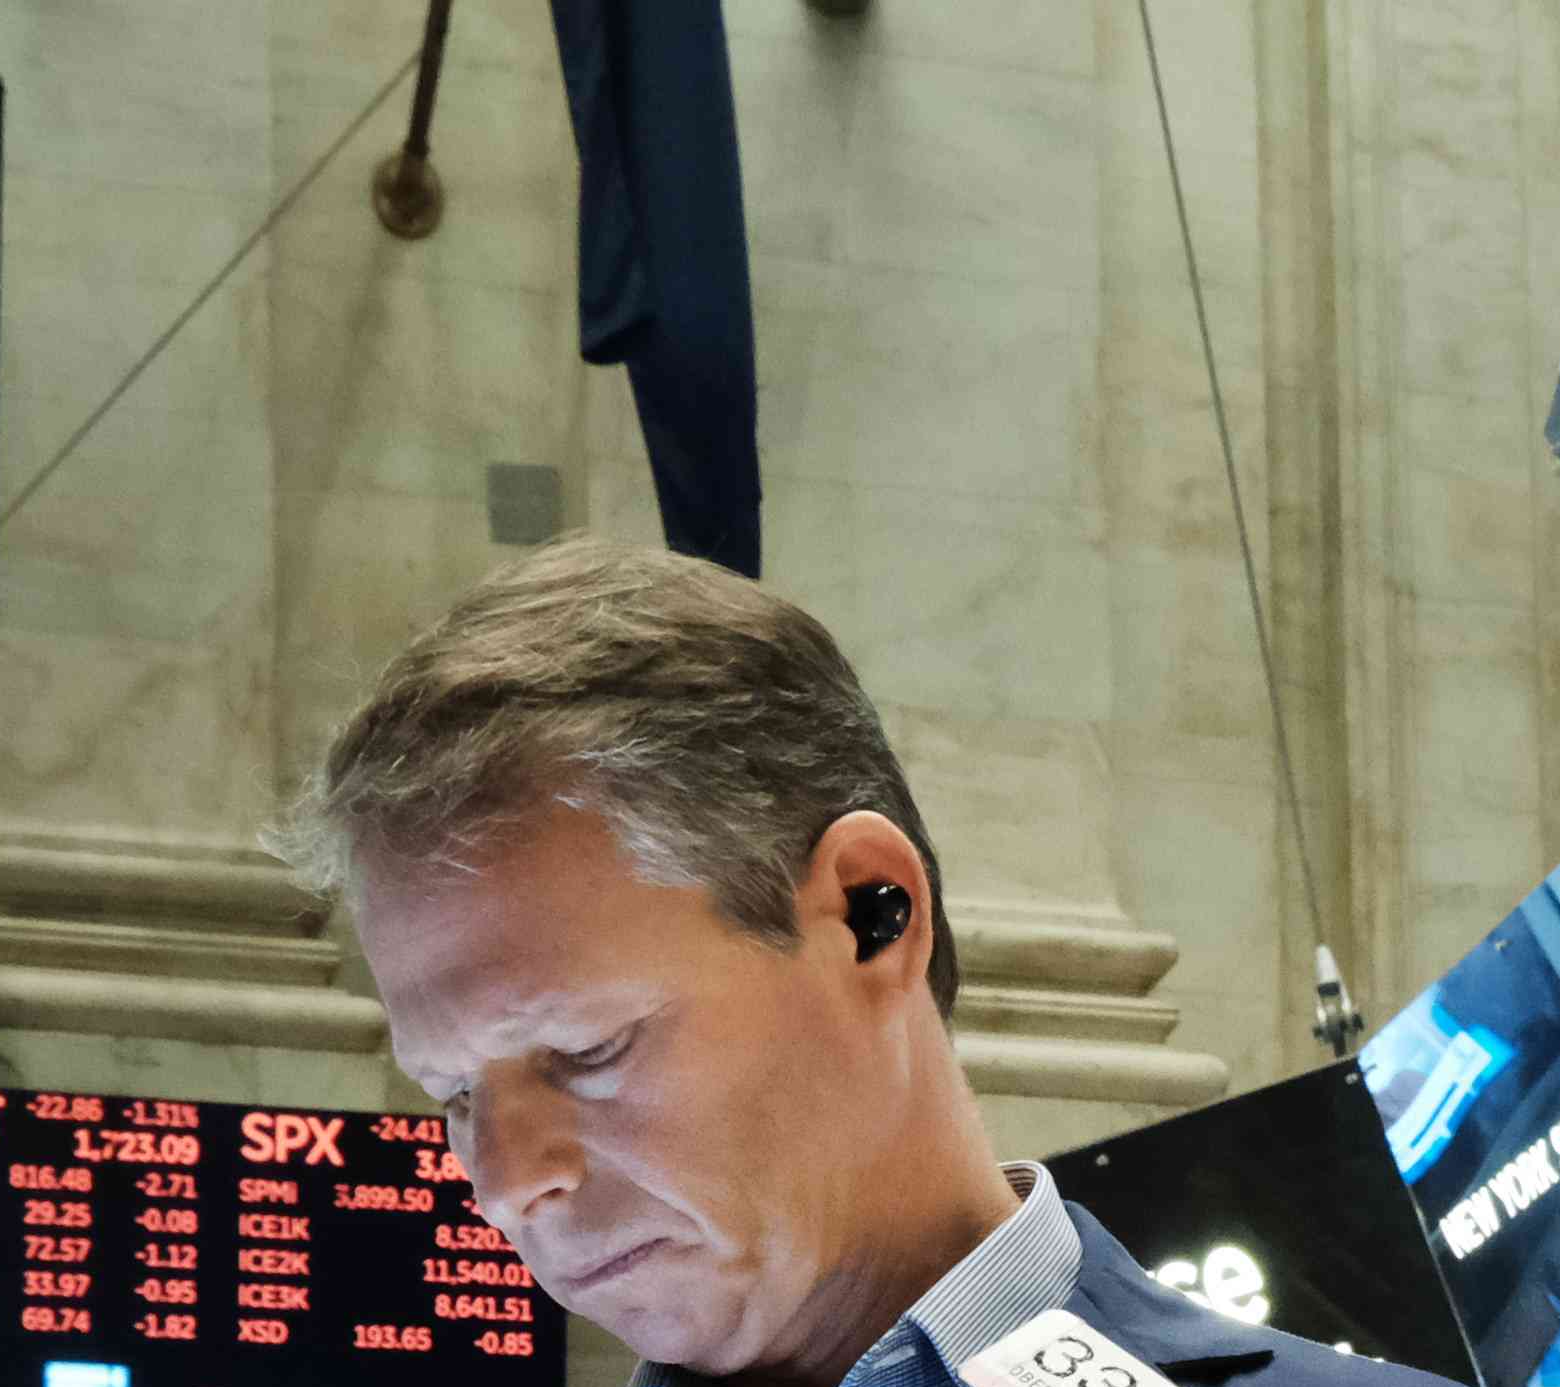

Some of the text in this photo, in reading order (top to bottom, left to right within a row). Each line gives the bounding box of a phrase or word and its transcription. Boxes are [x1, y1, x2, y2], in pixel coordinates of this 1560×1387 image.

[241, 1112, 344, 1167] SPX
[1439, 1197, 1503, 1260] NEW
[1488, 1138, 1559, 1217] YORK
